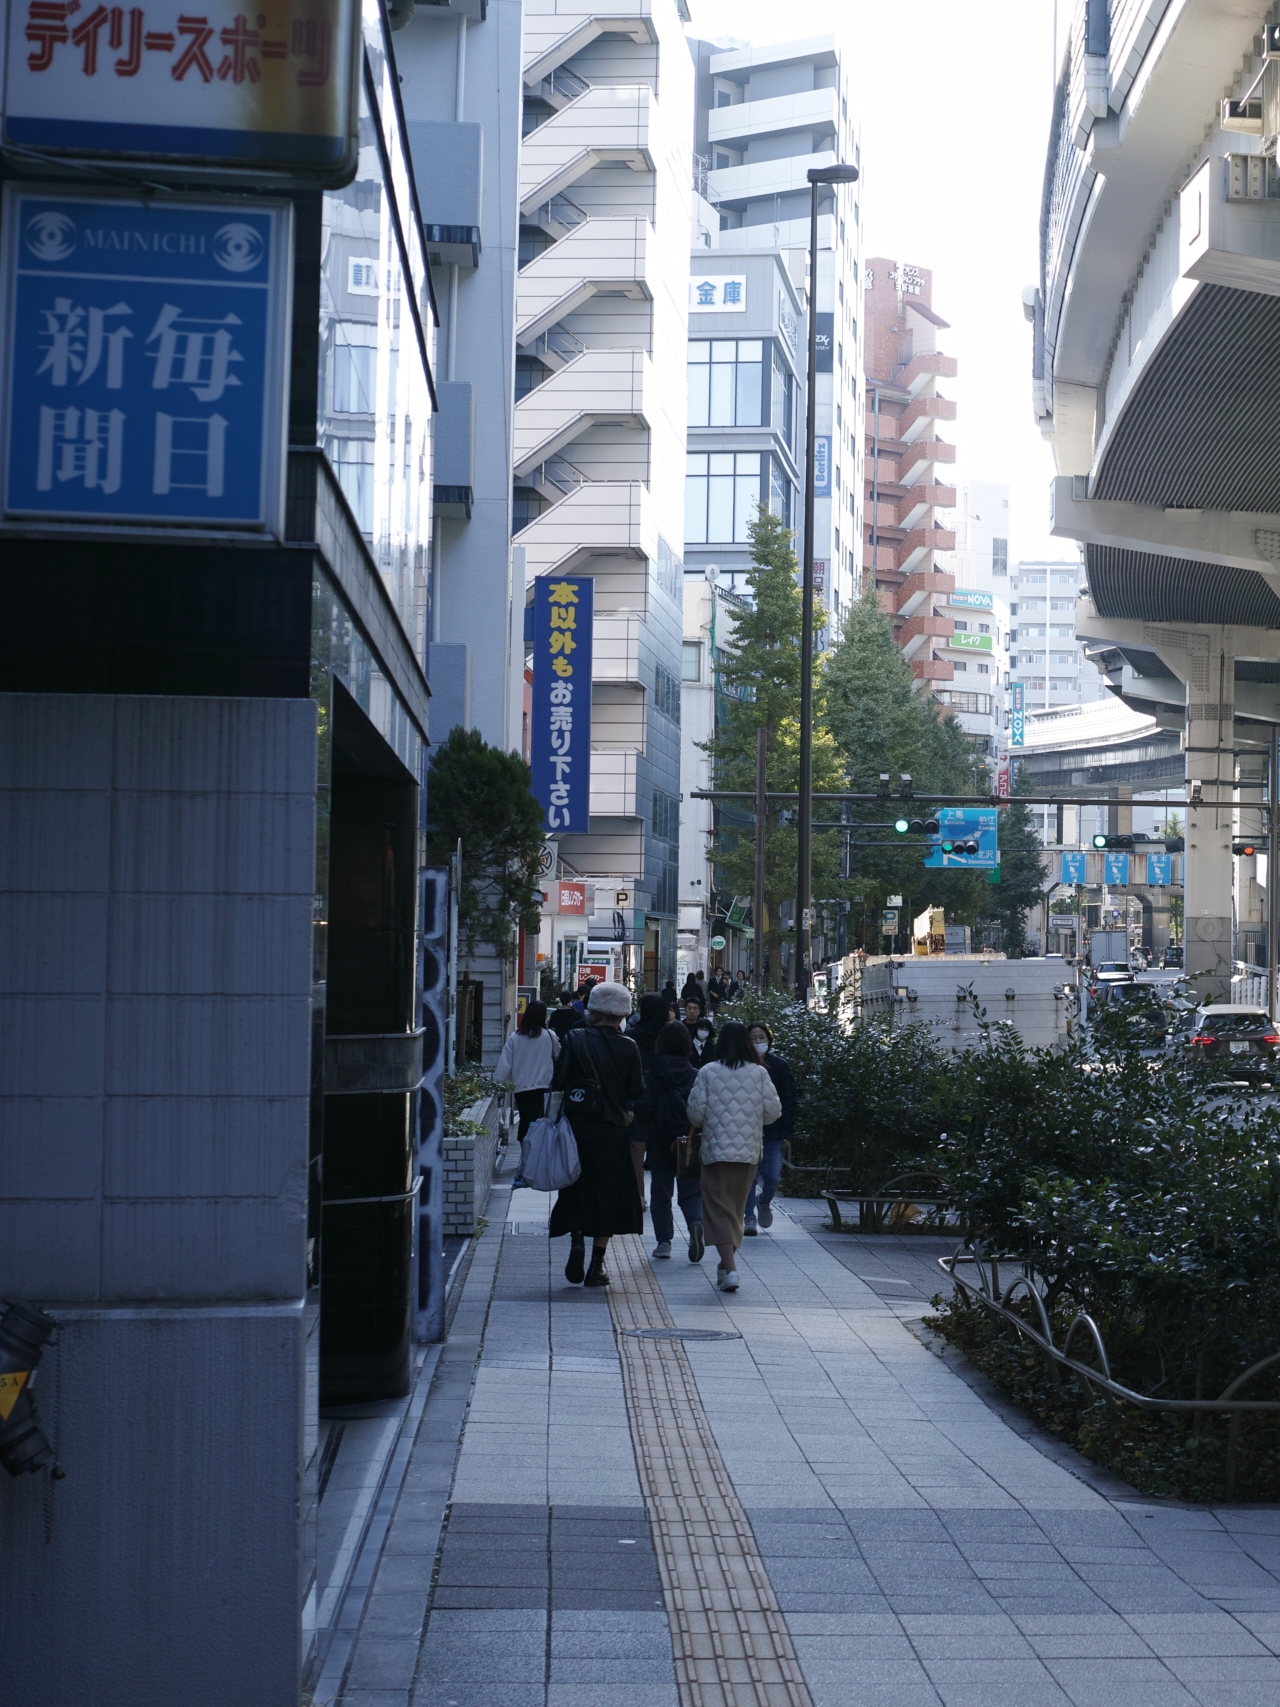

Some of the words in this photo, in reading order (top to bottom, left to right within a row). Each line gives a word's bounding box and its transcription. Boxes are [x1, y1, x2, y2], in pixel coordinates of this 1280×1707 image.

[24, 0, 334, 86] デイリースポーツ
[83, 229, 207, 255] MAINICHI
[696, 280, 742, 305] 金庫
[35, 297, 134, 495] 新聞
[145, 303, 244, 497] 毎日
[815, 442, 826, 482] Berlitz
[967, 594, 992, 606] NOVA
[961, 634, 981, 645] レイク
[548, 581, 579, 829] 本以外もお売り下さい
[1013, 711, 1023, 742] NOVA
[616, 892, 629, 905] P
[884, 911, 896, 924] P
